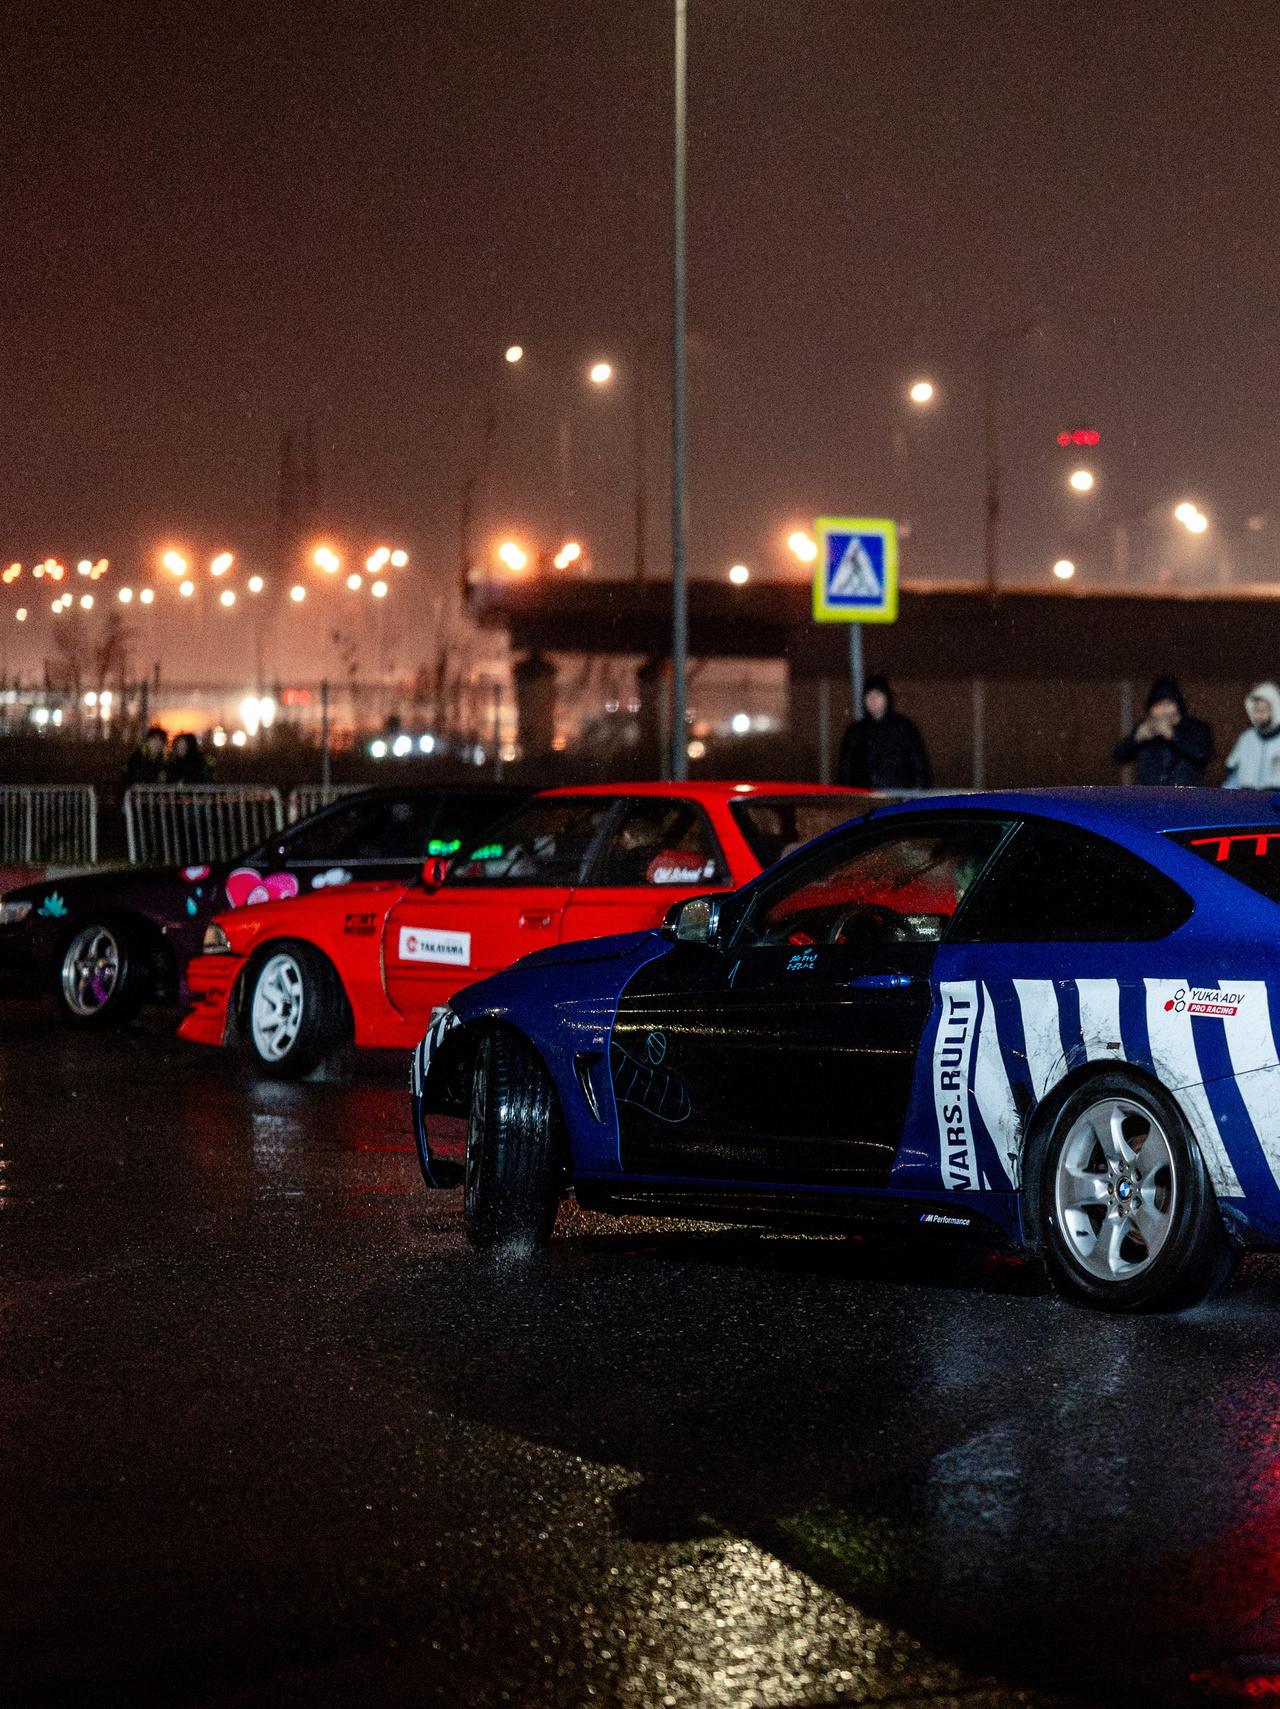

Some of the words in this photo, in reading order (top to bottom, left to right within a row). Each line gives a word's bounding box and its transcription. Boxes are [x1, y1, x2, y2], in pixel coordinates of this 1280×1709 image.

[420, 942, 463, 956] TAKAYAMA
[1192, 990, 1219, 1002] YUKA
[1220, 993, 1245, 1004] ADV
[1190, 1004, 1206, 1013] PRO
[1206, 1005, 1234, 1015] RACING
[933, 1215, 970, 1226] Performance
